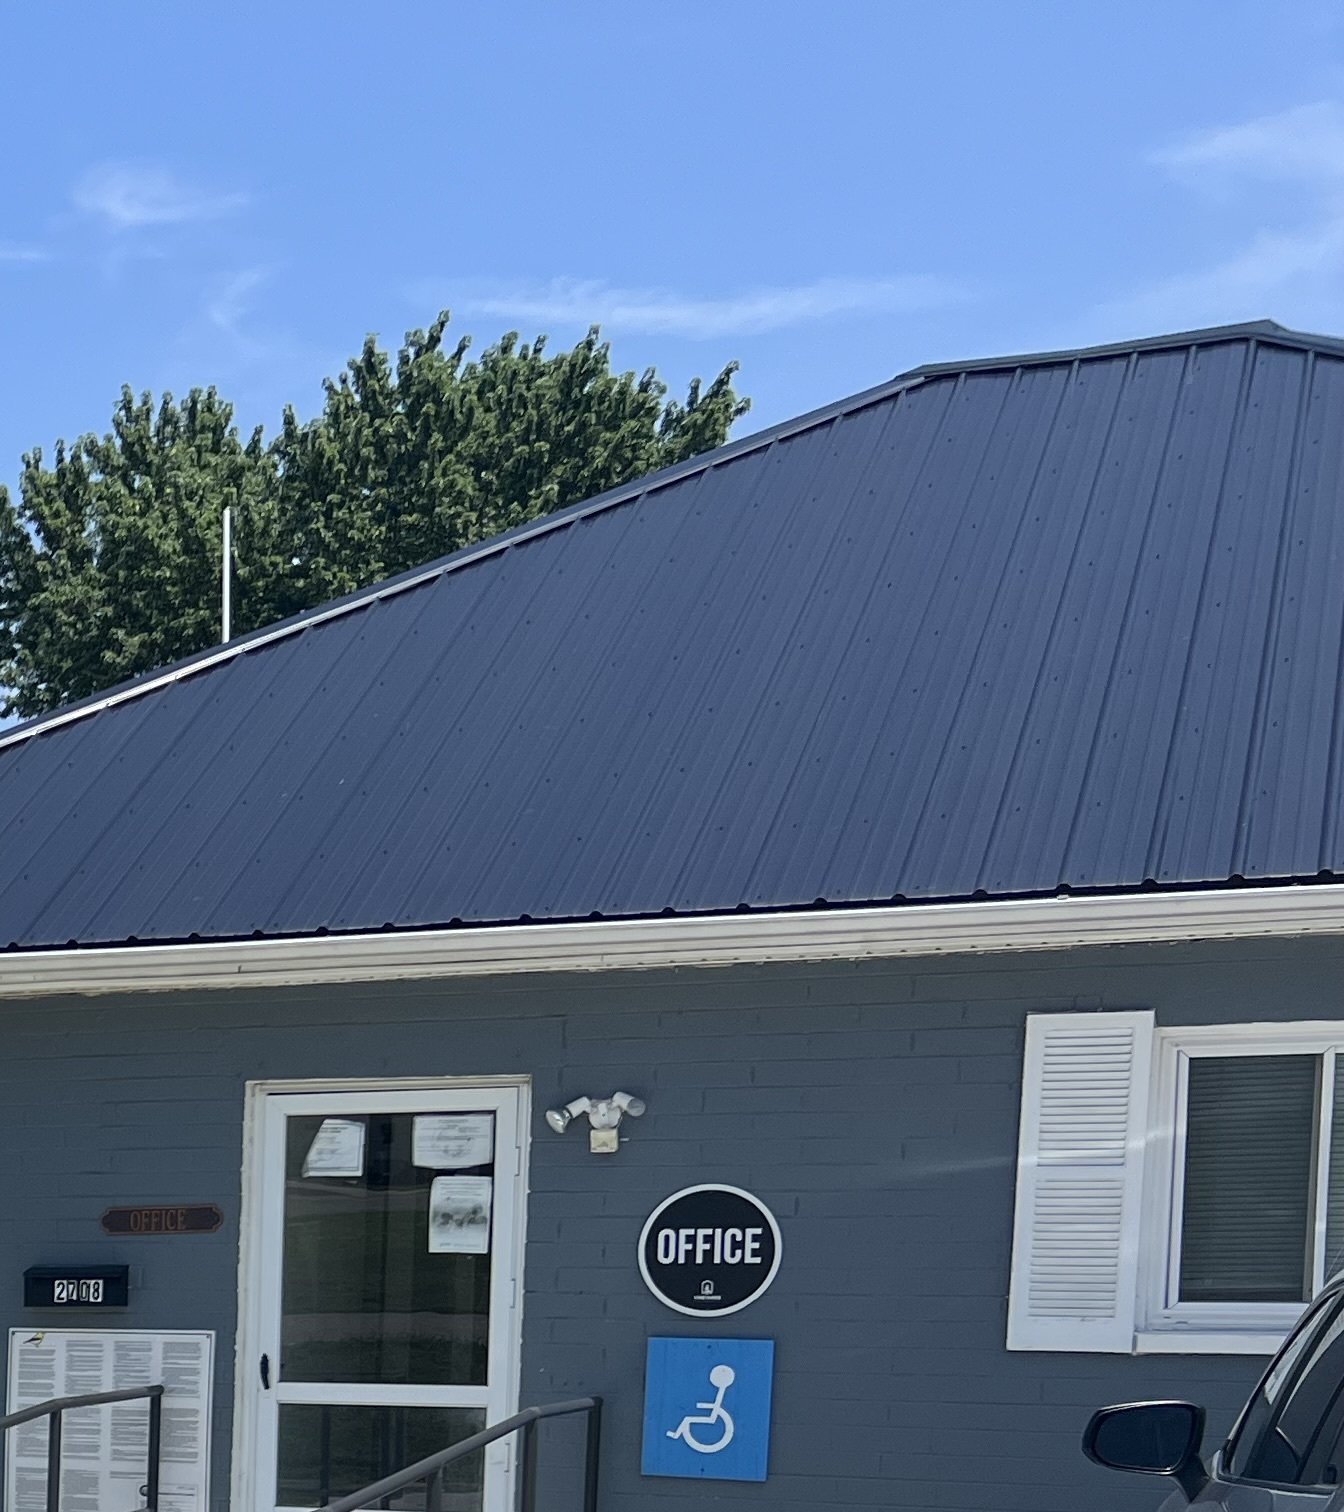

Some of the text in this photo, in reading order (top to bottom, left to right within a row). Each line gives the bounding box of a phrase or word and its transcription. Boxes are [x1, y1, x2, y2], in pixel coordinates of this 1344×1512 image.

[129, 1208, 188, 1232] OFFICE
[657, 1227, 763, 1265] OFFICE
[55, 1280, 102, 1302] 2708
